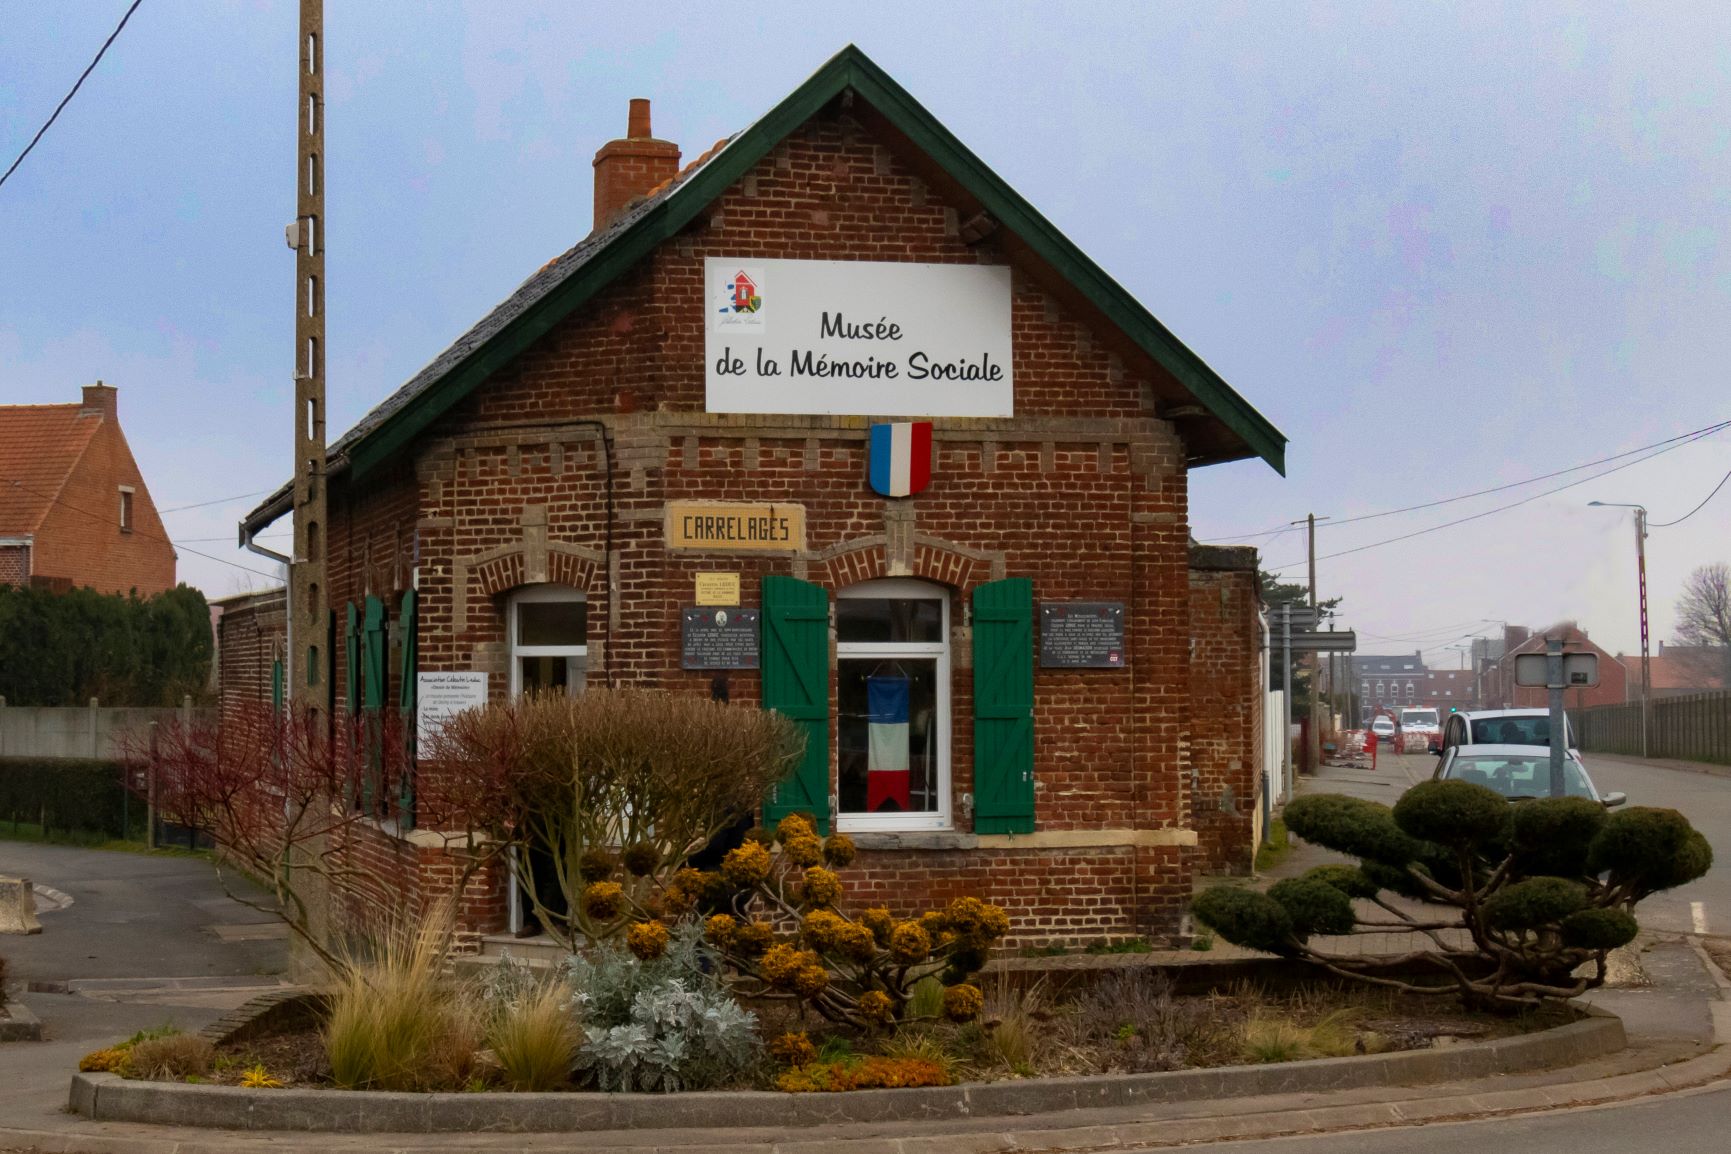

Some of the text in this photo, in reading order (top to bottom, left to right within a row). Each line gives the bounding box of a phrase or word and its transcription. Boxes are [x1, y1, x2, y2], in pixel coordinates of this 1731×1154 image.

[820, 311, 903, 341] Musée
[716, 347, 1004, 381] de la Mémoire Sociale
[683, 516, 789, 541] CARRELAGES
